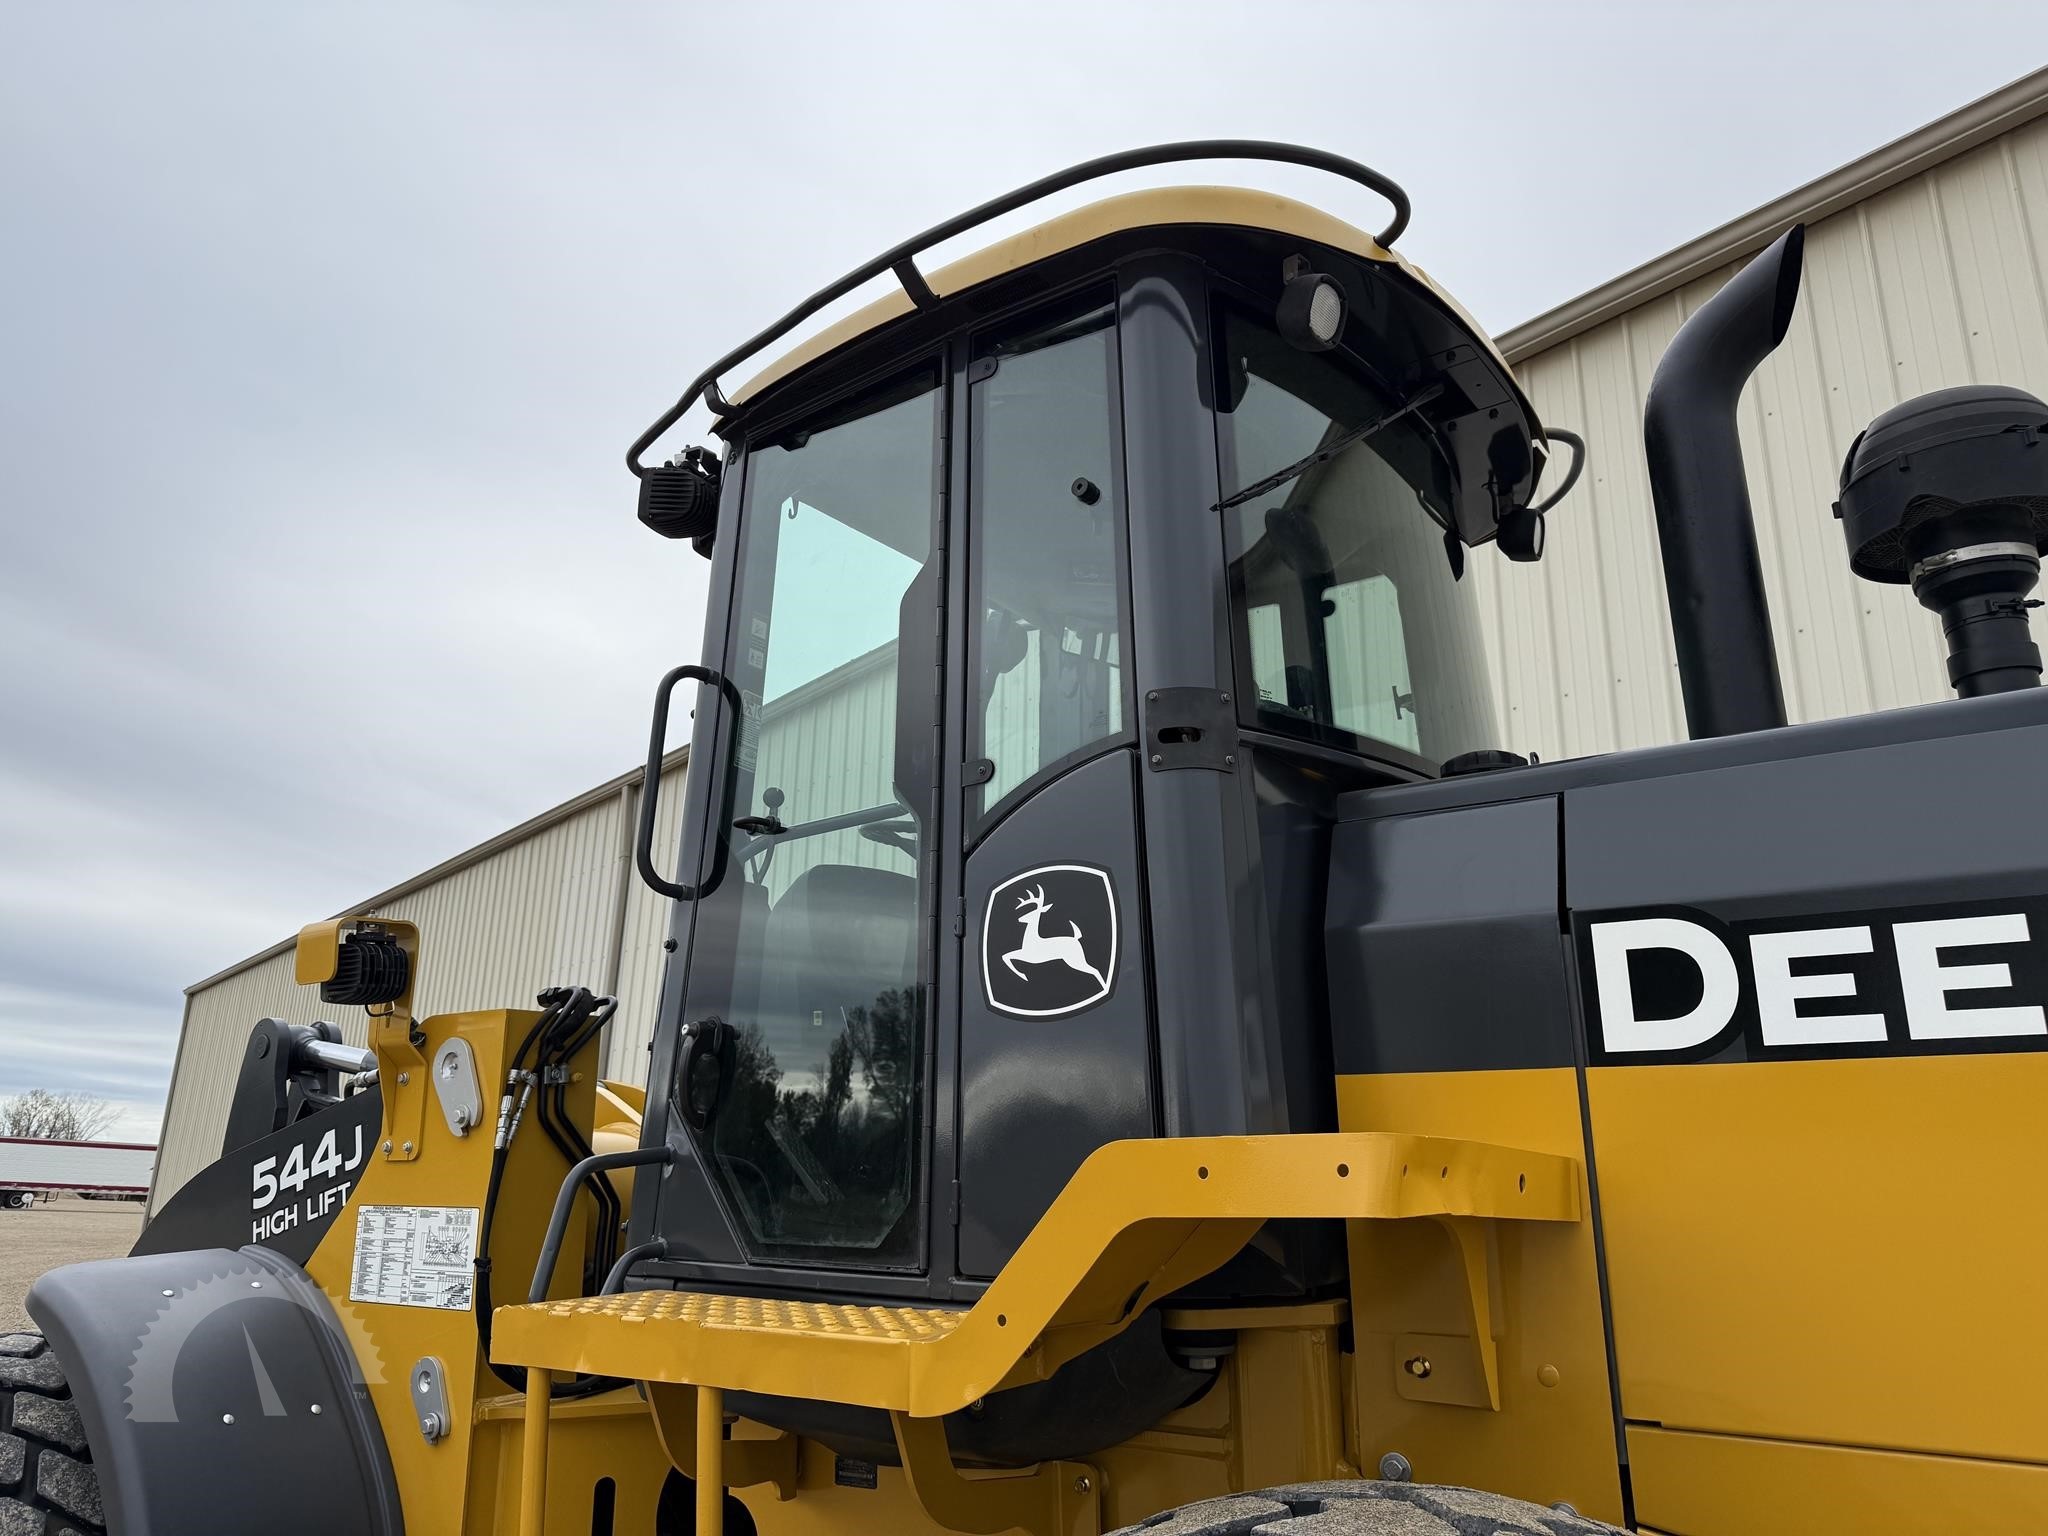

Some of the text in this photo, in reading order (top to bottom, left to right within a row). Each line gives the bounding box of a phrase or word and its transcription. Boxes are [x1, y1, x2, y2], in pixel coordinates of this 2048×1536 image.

[1590, 913, 2048, 1053] DEE
[252, 1124, 363, 1210] 544J
[252, 1181, 351, 1244] HIGH LIFT
